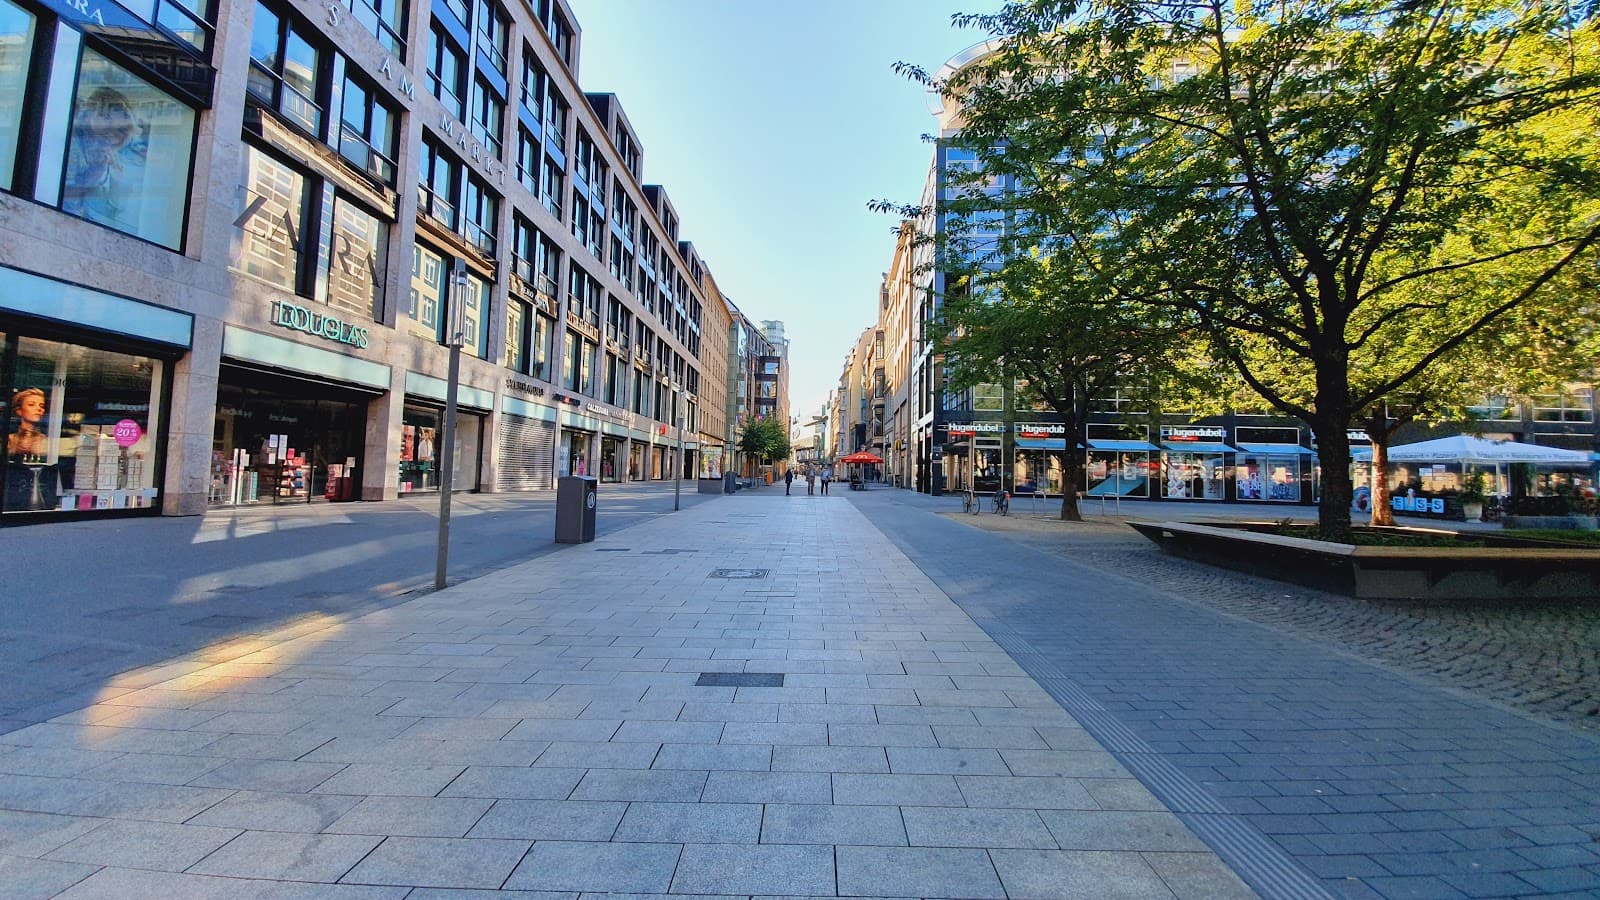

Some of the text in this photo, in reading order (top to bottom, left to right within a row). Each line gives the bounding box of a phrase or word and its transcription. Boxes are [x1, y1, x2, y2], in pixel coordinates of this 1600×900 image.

[66, 0, 105, 27] RA
[379, 57, 415, 101] AM
[440, 114, 506, 186] MARKT
[232, 184, 381, 289] ZARA
[278, 300, 369, 349] DOUGLAS
[948, 423, 999, 433] Hugendubel
[1021, 424, 1065, 434] Hugendub
